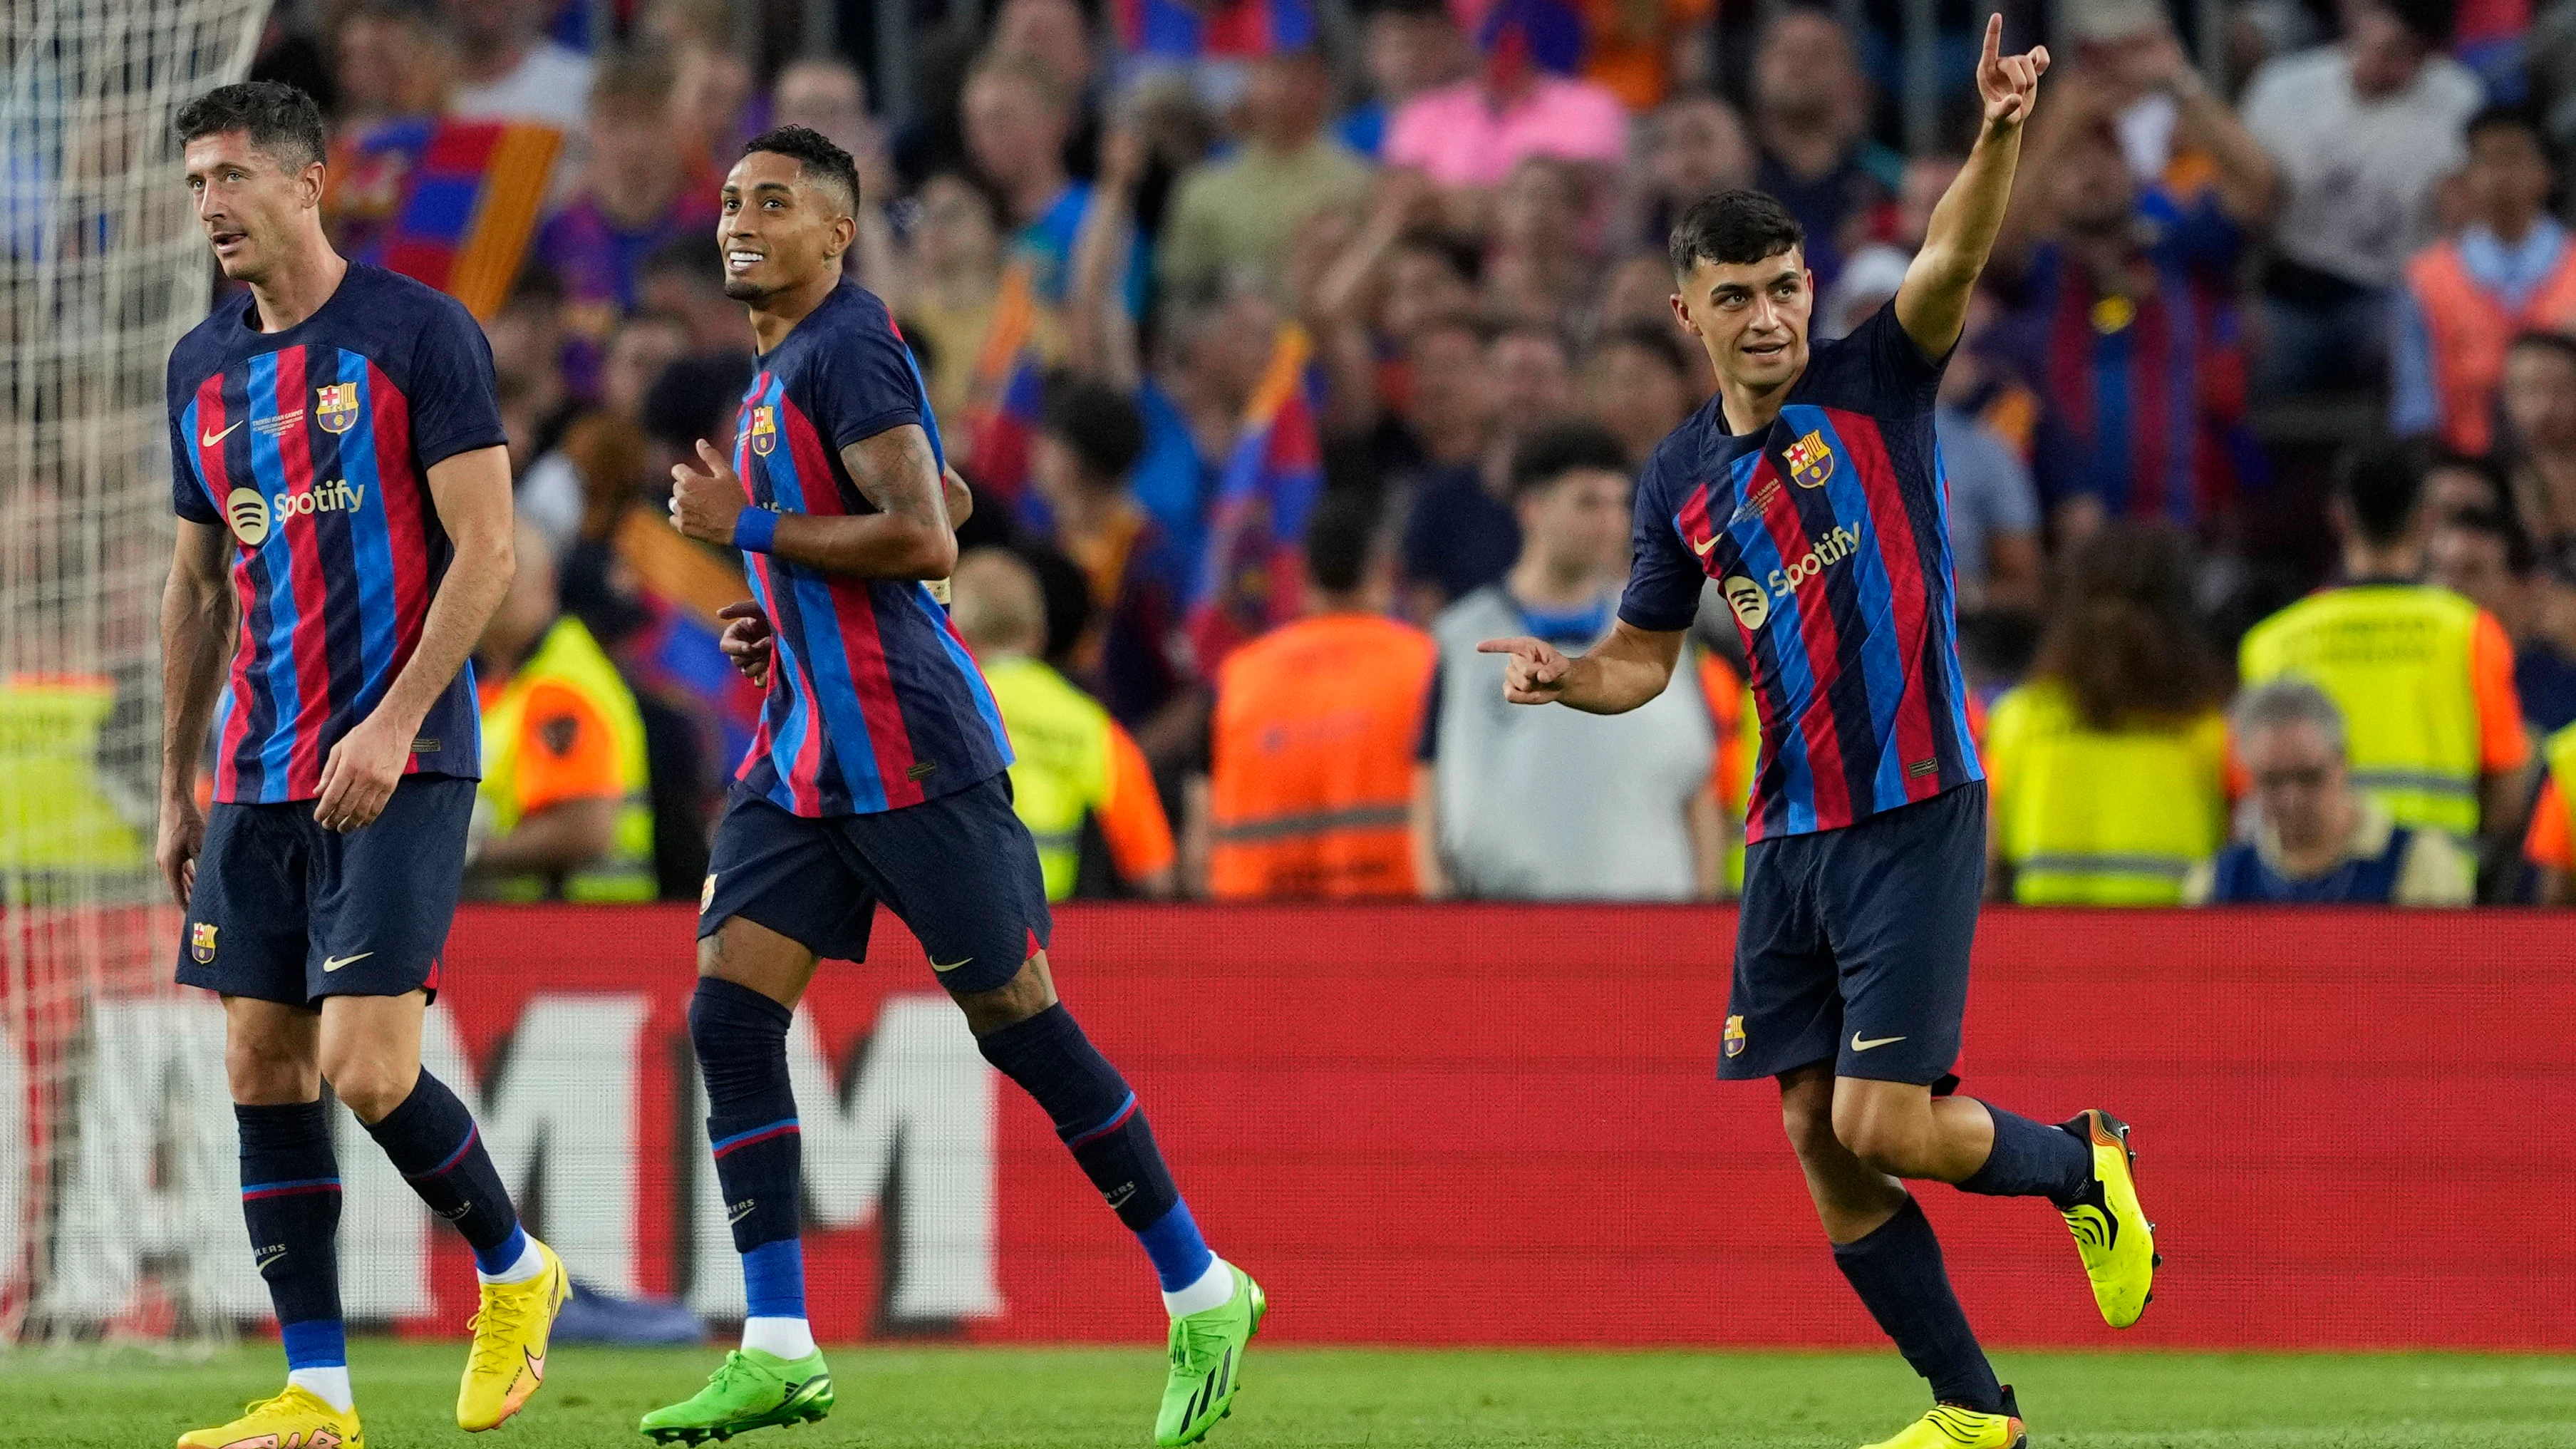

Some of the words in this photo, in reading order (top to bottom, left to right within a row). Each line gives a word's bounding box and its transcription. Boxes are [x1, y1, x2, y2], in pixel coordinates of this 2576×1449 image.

[1801, 454, 1819, 469] FCB
[273, 478, 365, 525] Spotify
[1768, 520, 1861, 597] Spotify
[0, 996, 1005, 1319] AMM
